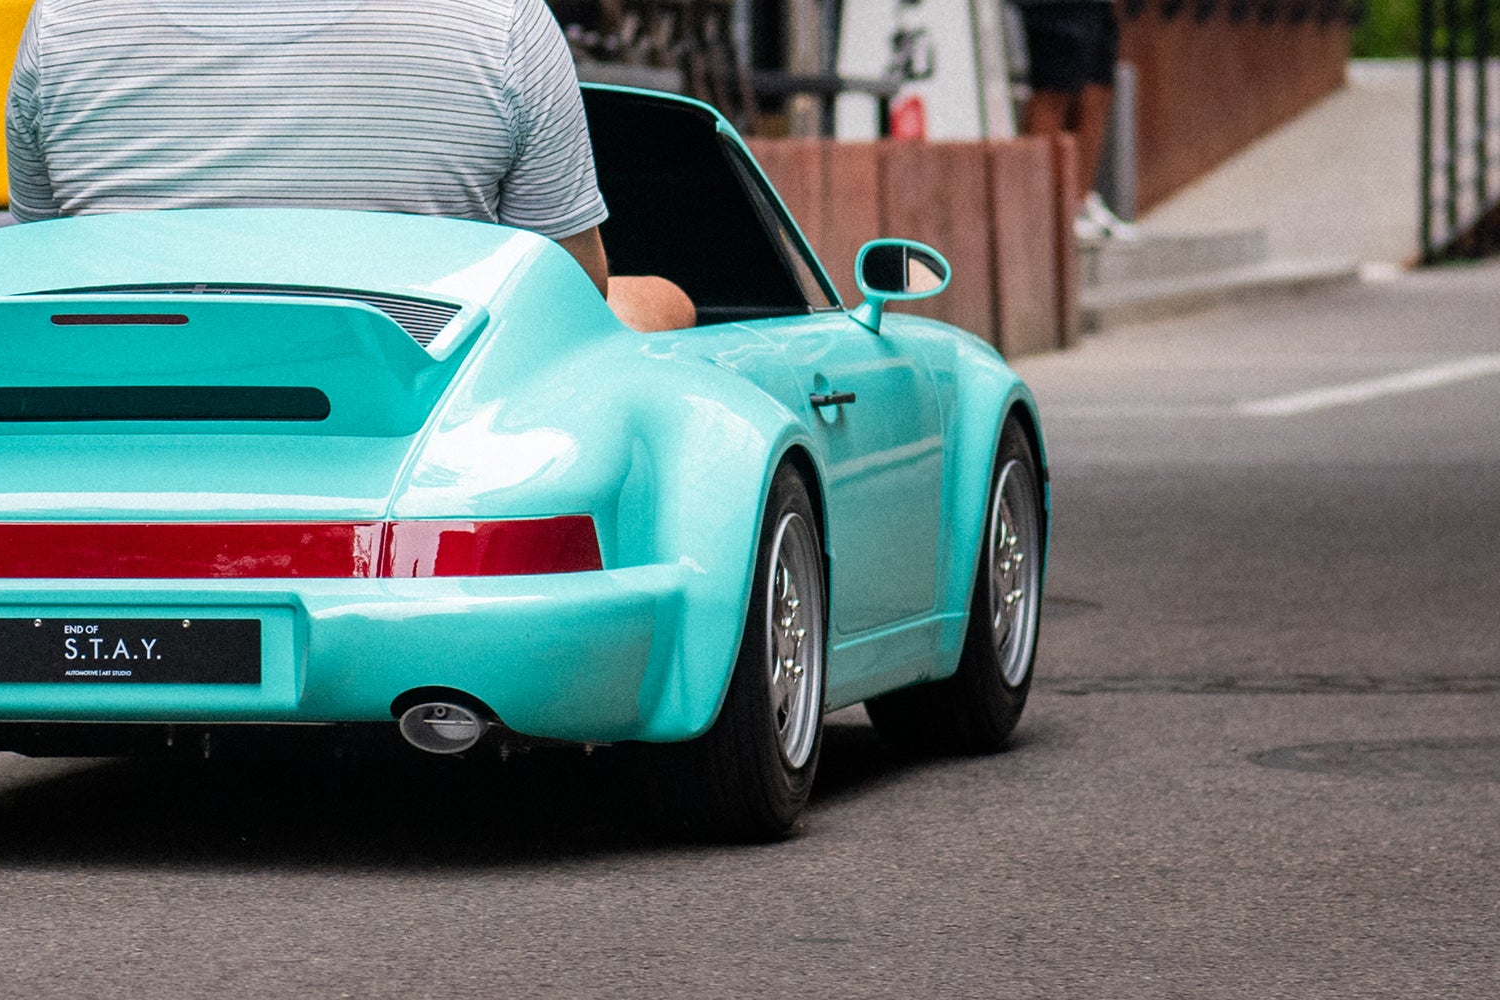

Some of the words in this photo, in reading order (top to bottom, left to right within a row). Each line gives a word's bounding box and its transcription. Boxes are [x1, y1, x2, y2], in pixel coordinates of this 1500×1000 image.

[64, 625, 84, 634] END
[85, 625, 99, 634] OF
[64, 638, 162, 660] S.T.A.Y.
